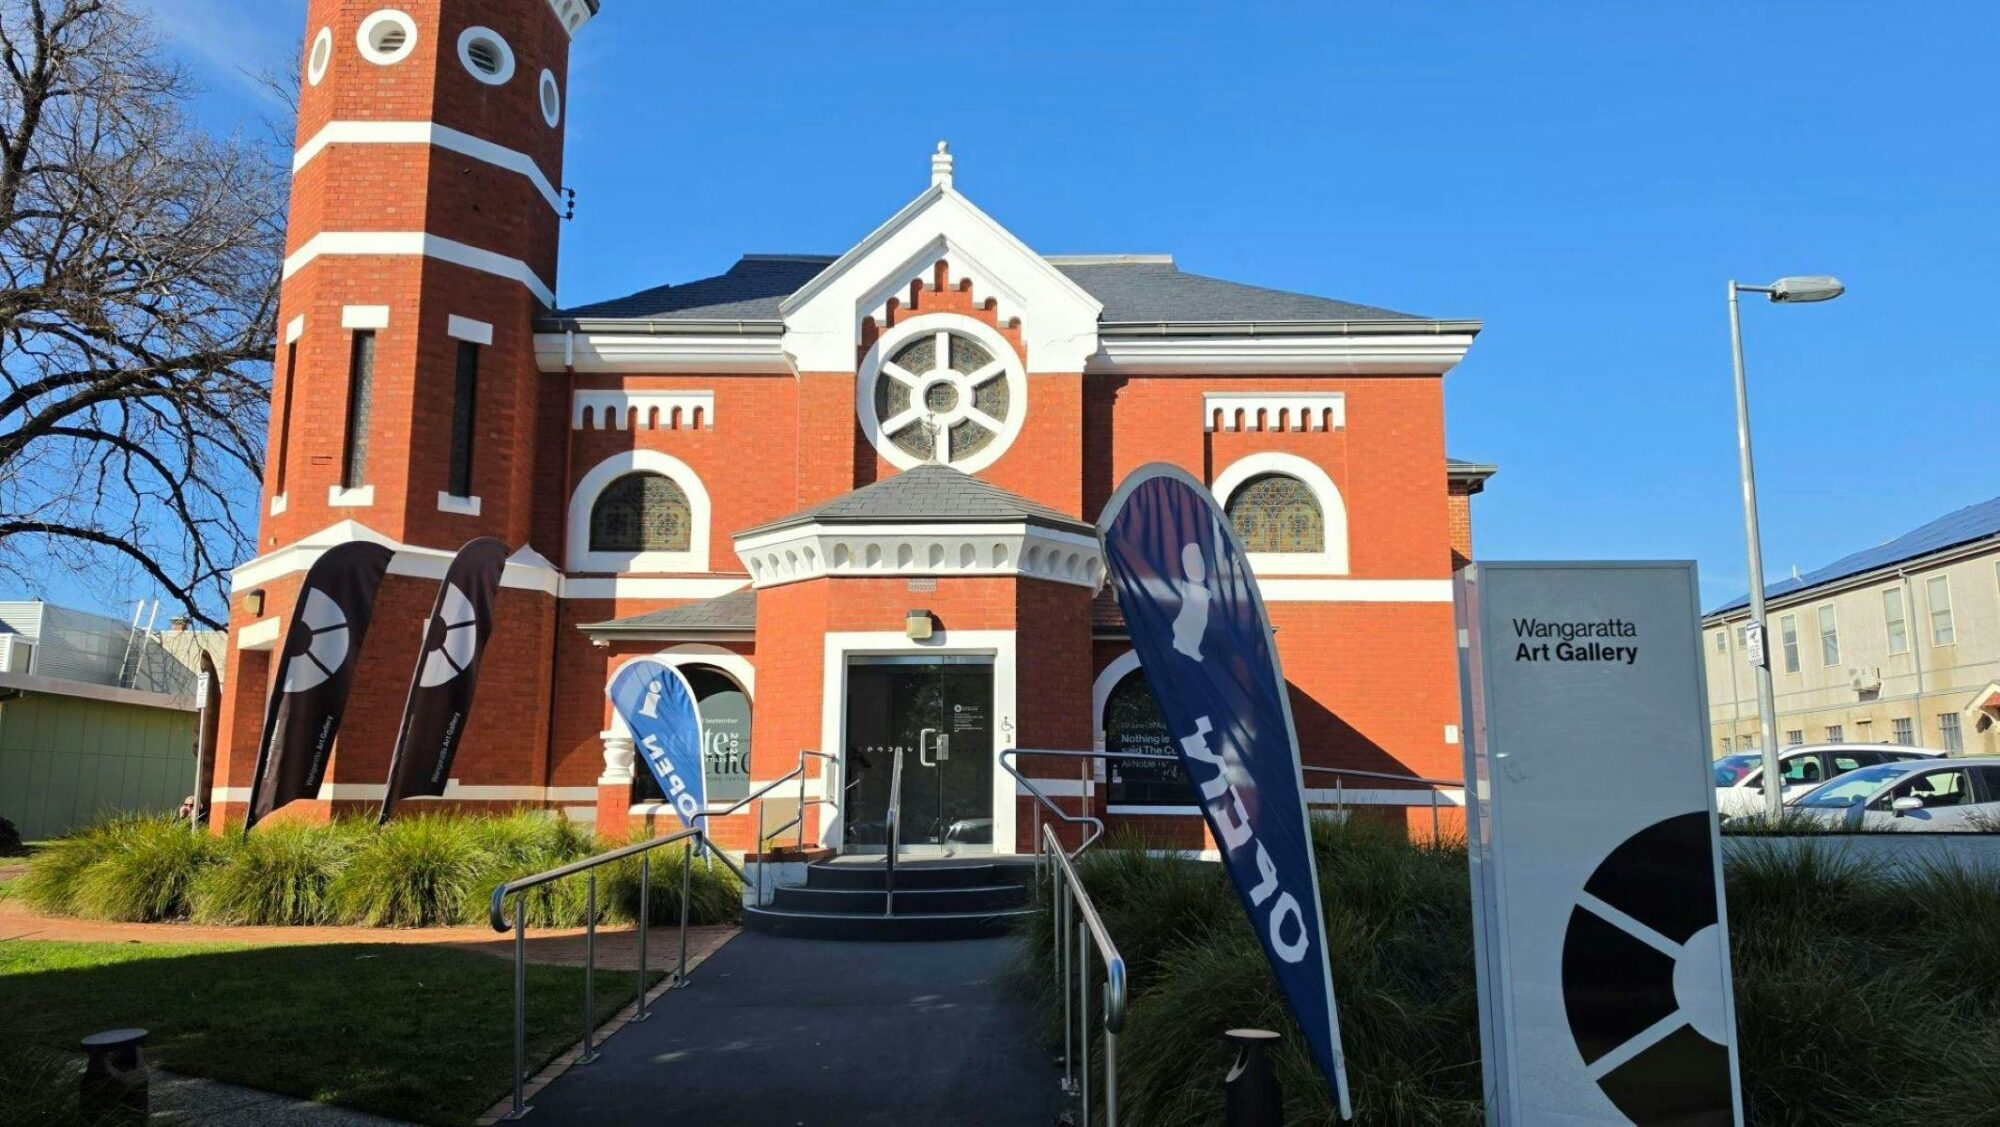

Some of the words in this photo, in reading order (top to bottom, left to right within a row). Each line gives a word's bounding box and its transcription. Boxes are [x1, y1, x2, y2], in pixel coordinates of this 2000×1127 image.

[1512, 618, 1638, 641] Wangaratta
[1515, 642, 1551, 661] Art
[1556, 642, 1638, 665] Gallery
[320, 715, 334, 739] Gallery
[446, 711, 461, 736] Gallery
[1121, 735, 1160, 745] Nothing
[1161, 735, 1170, 743] is
[1143, 745, 1163, 755] The
